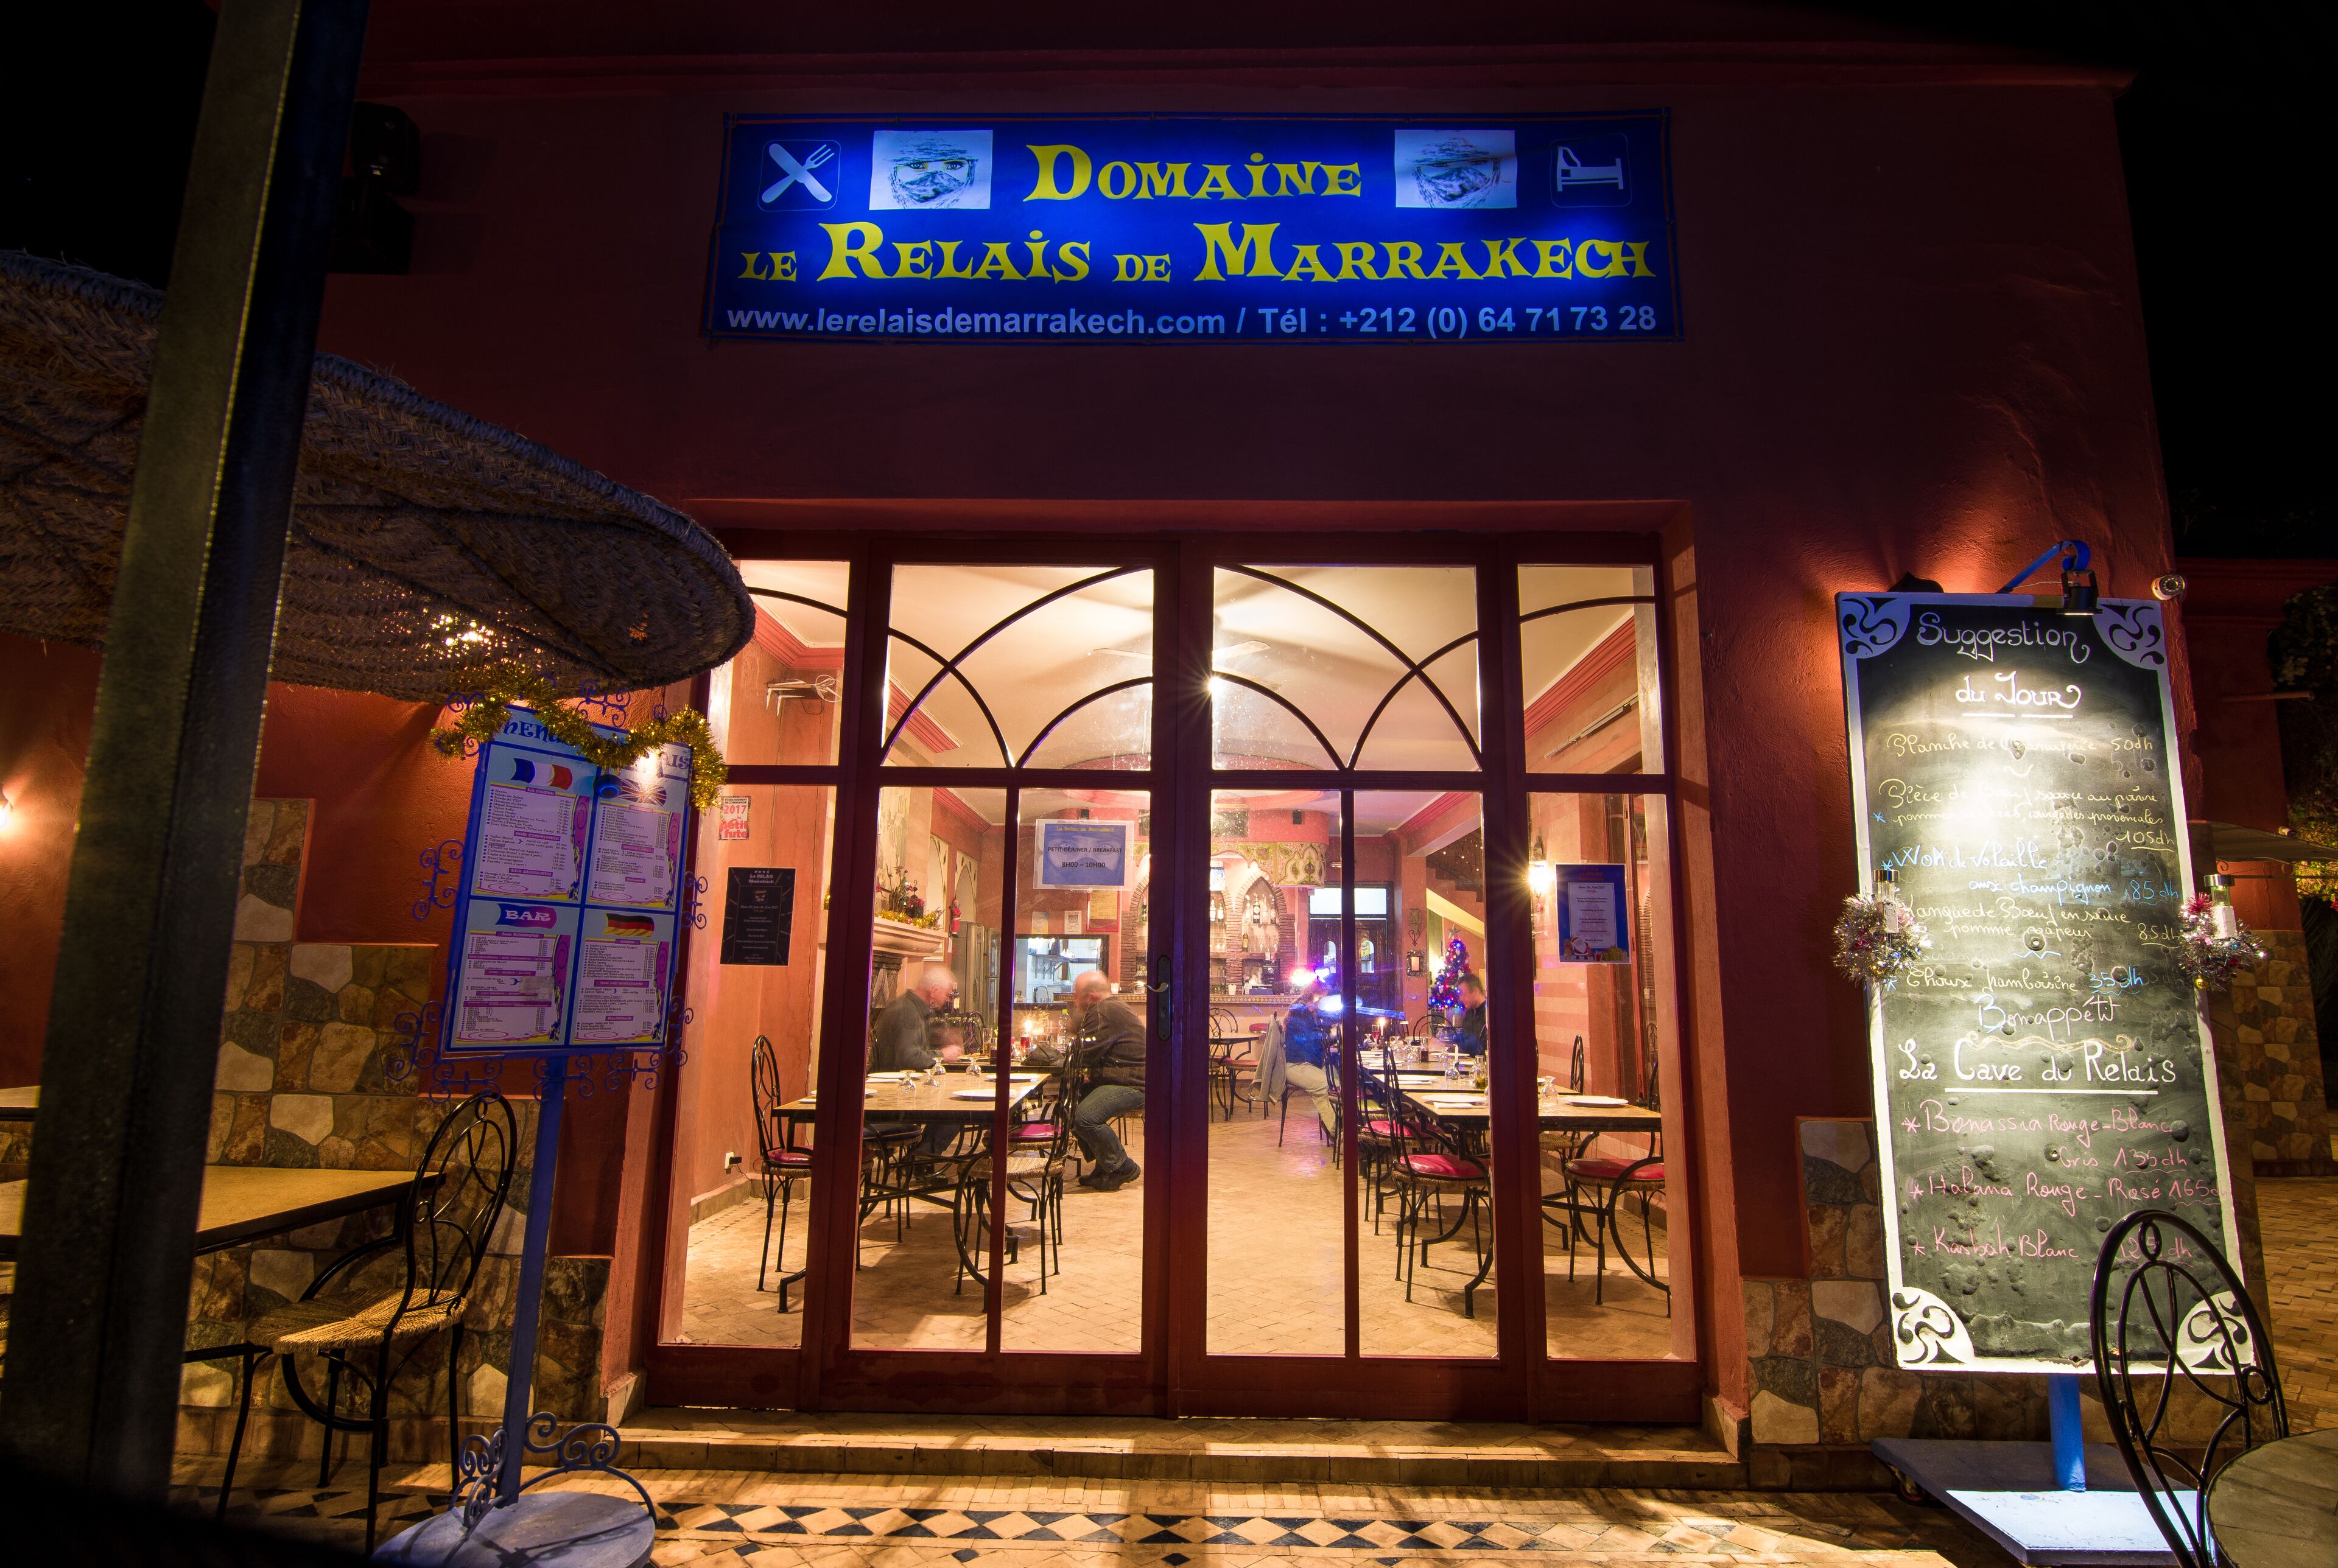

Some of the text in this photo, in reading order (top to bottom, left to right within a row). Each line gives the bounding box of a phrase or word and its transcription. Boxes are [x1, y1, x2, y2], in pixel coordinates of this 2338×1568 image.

[737, 220, 1657, 284] LE RELAIS DE MARRAKECH
[727, 306, 1226, 334] www.lerelaisdemarrakech.com
[1258, 306, 1307, 333] Tél
[1339, 307, 1417, 332] +212
[1428, 306, 1466, 338] (0)
[1478, 307, 1516, 332] 64
[1530, 307, 1560, 331] 71
[1570, 306, 1608, 331] 73
[1619, 305, 1657, 331] 28
[1917, 612, 2090, 664] Suggestion
[1955, 676, 1987, 704] du
[1887, 732, 1970, 757] Planche
[1977, 733, 1995, 751] de
[1879, 778, 1942, 808] Pièce
[1948, 784, 1968, 799] de
[2087, 793, 2112, 802] au
[724, 805, 746, 814] 2017
[720, 820, 748, 831] petit
[505, 909, 550, 922] BAR
[1898, 1037, 2177, 1083] La Cave du Relais
[1920, 1099, 2041, 1133] Bonassia
[2059, 1146, 2099, 1168] Gris
[2026, 1171, 2087, 1217] Rouge
[2108, 1177, 2161, 1200] Rosé
[2019, 1228, 2079, 1259] Blanc
